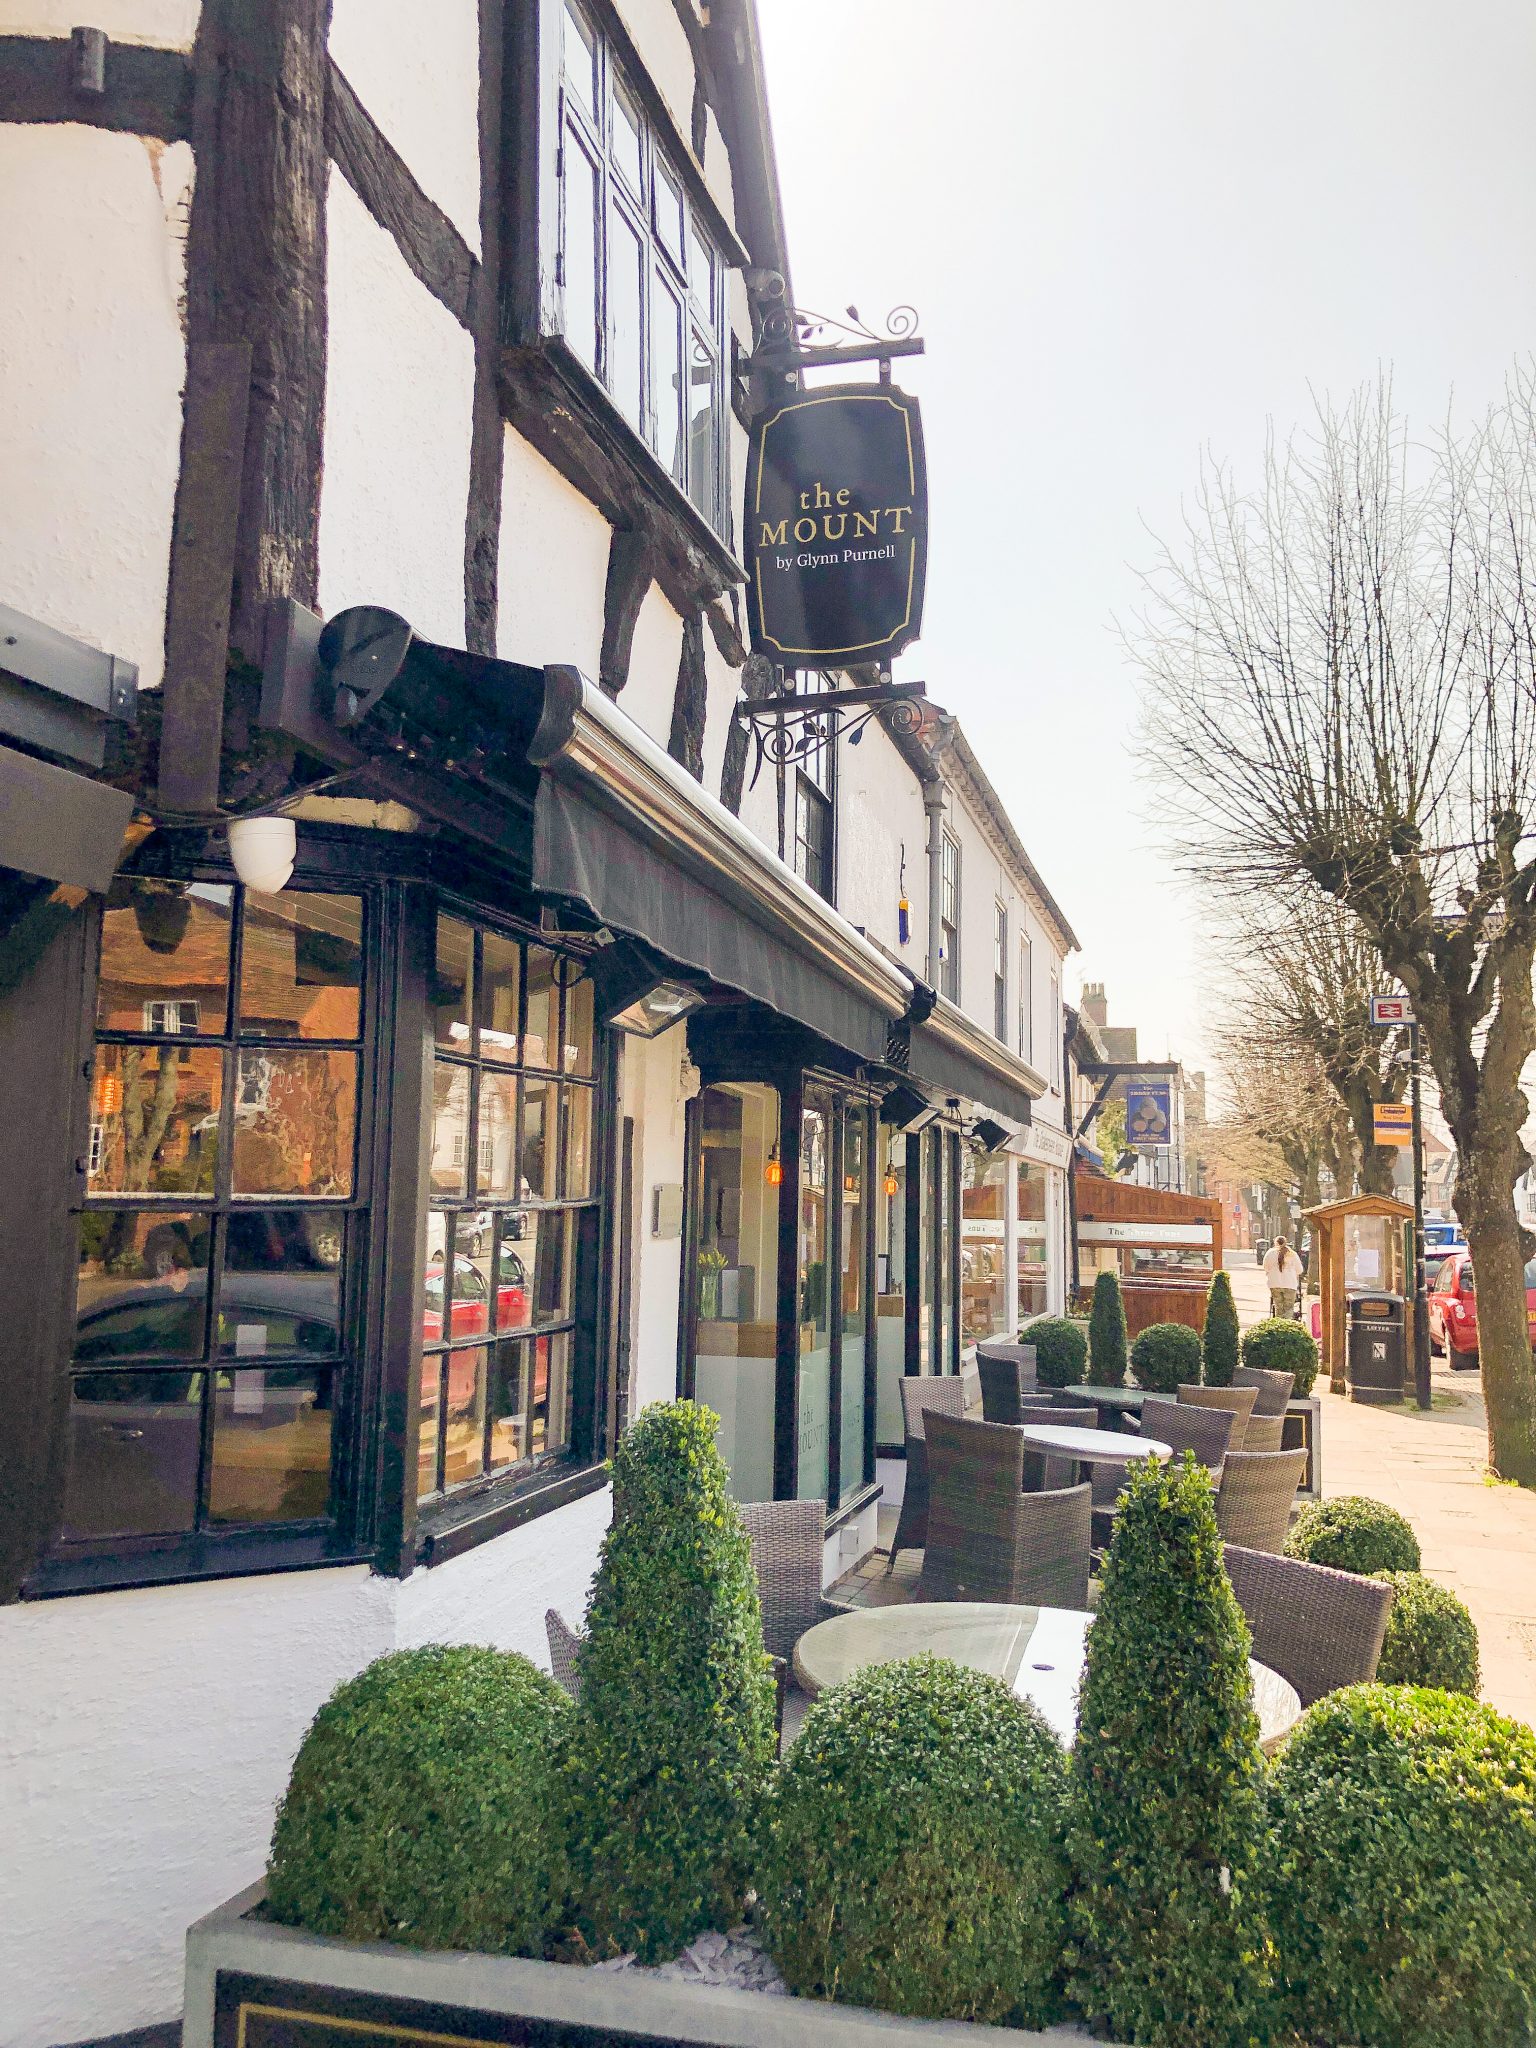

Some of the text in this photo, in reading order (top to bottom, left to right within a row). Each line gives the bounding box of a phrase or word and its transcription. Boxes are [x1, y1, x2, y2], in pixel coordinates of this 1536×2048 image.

[800, 481, 850, 510] the
[758, 506, 912, 547] MOUNT
[776, 545, 896, 571] by Glynn Purnell
[1108, 1227, 1125, 1236] The
